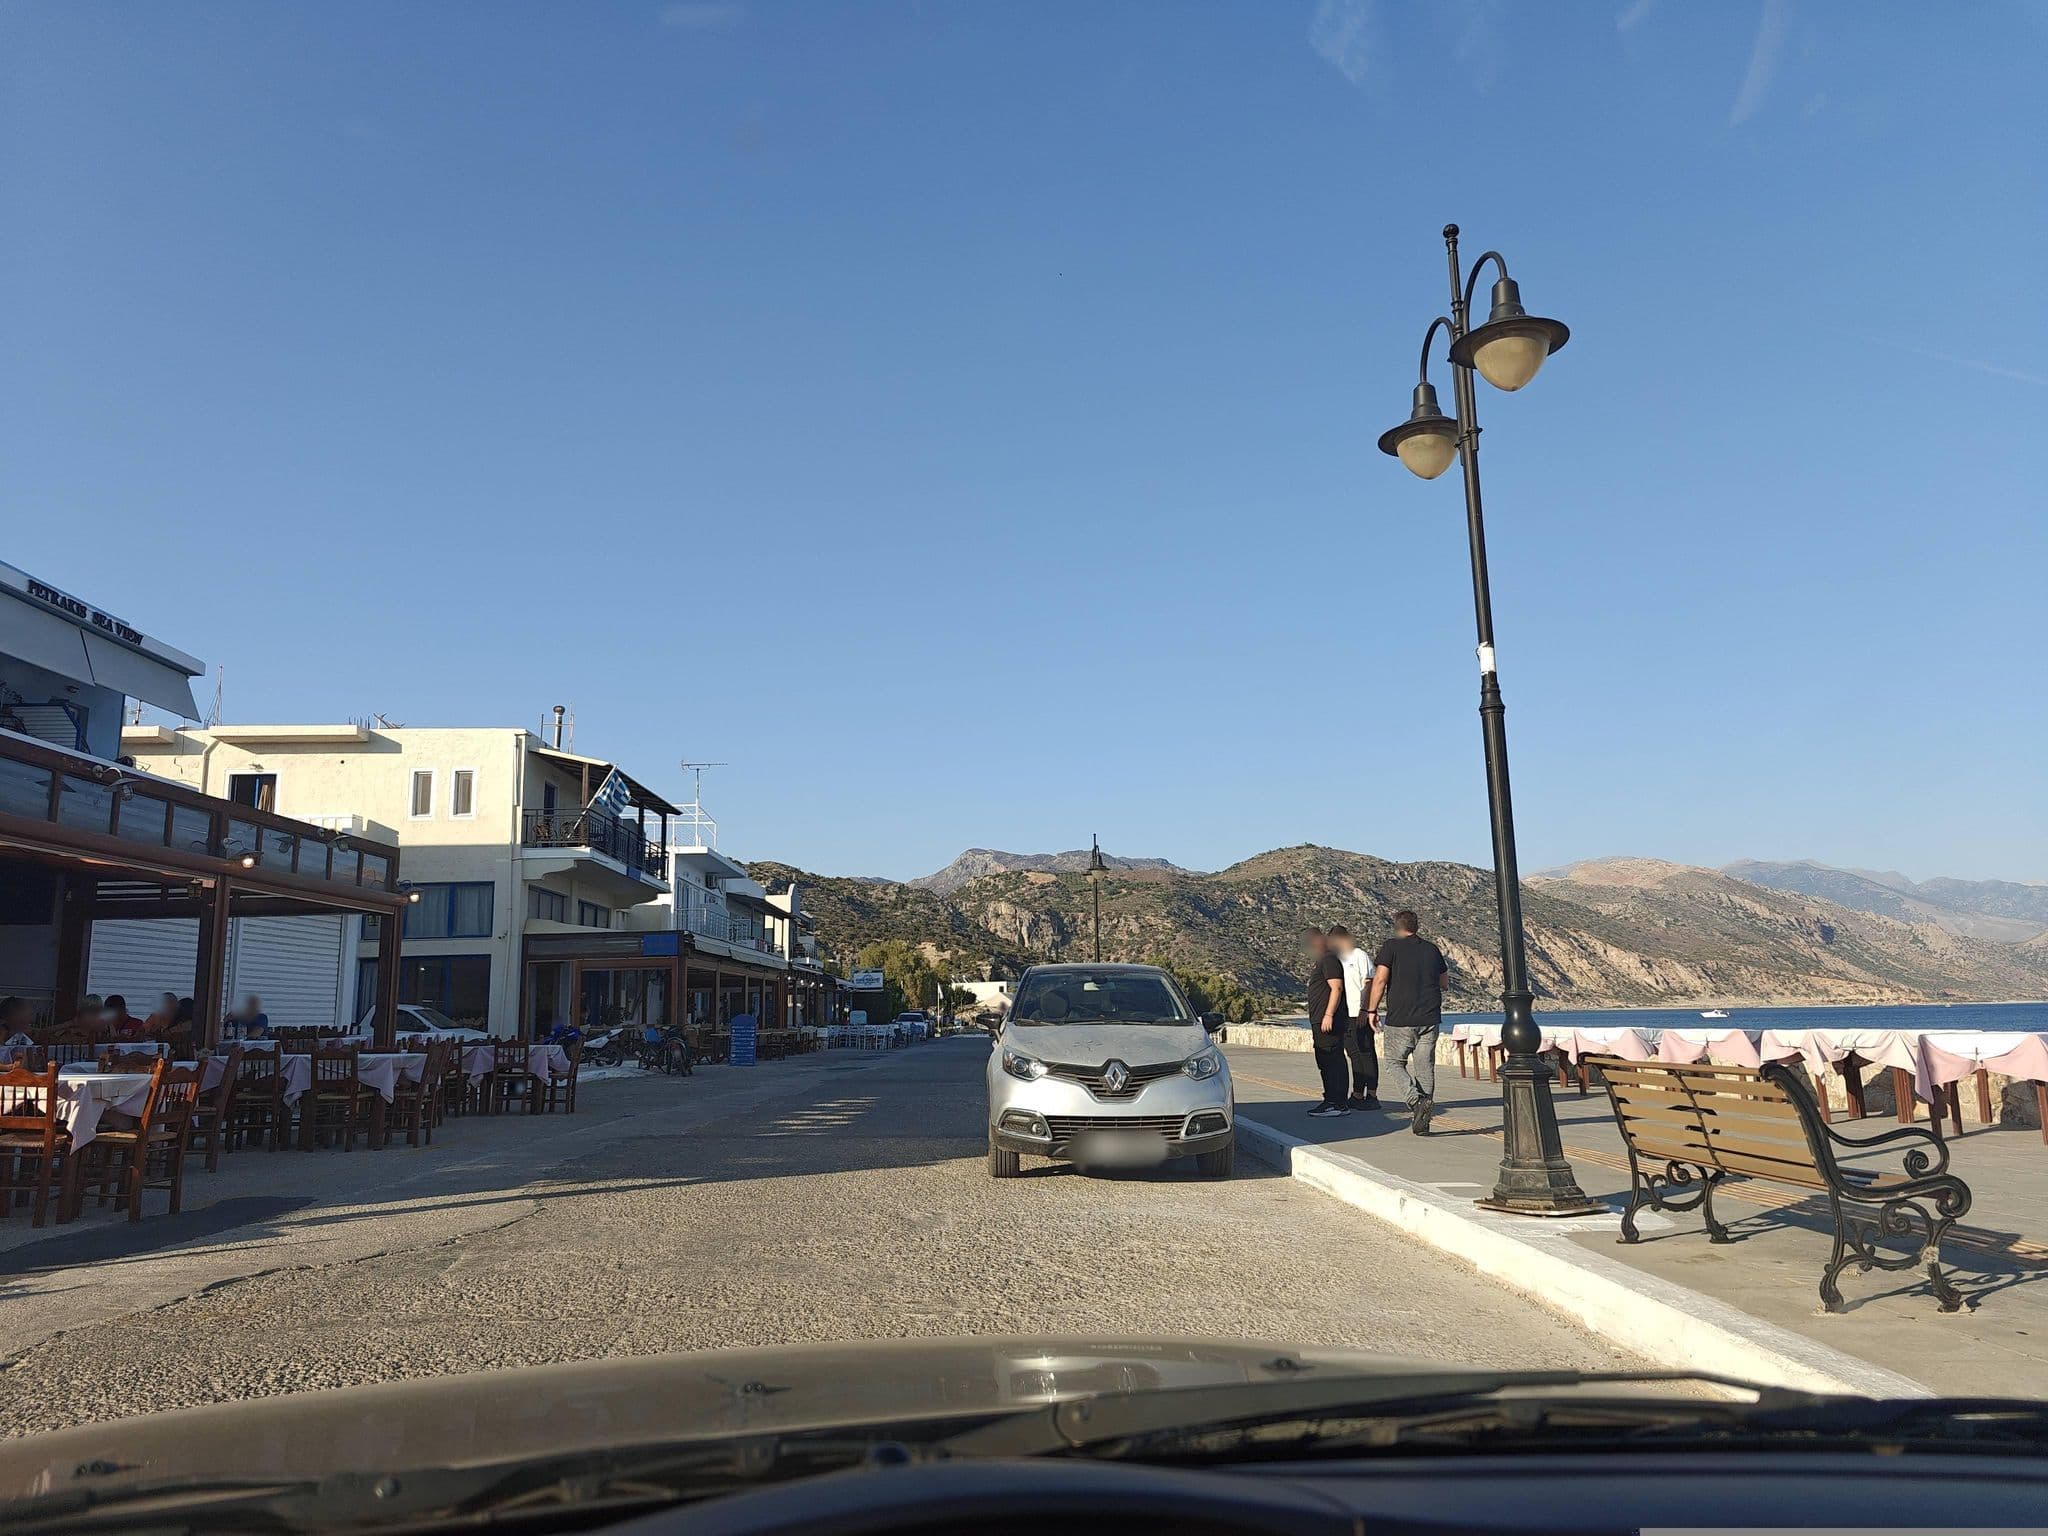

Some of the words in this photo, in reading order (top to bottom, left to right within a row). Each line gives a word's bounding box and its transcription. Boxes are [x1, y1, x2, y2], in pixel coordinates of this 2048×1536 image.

[27, 579, 87, 619] PETRAKIS
[92, 611, 114, 633] SEA
[115, 622, 144, 646] VIEW
